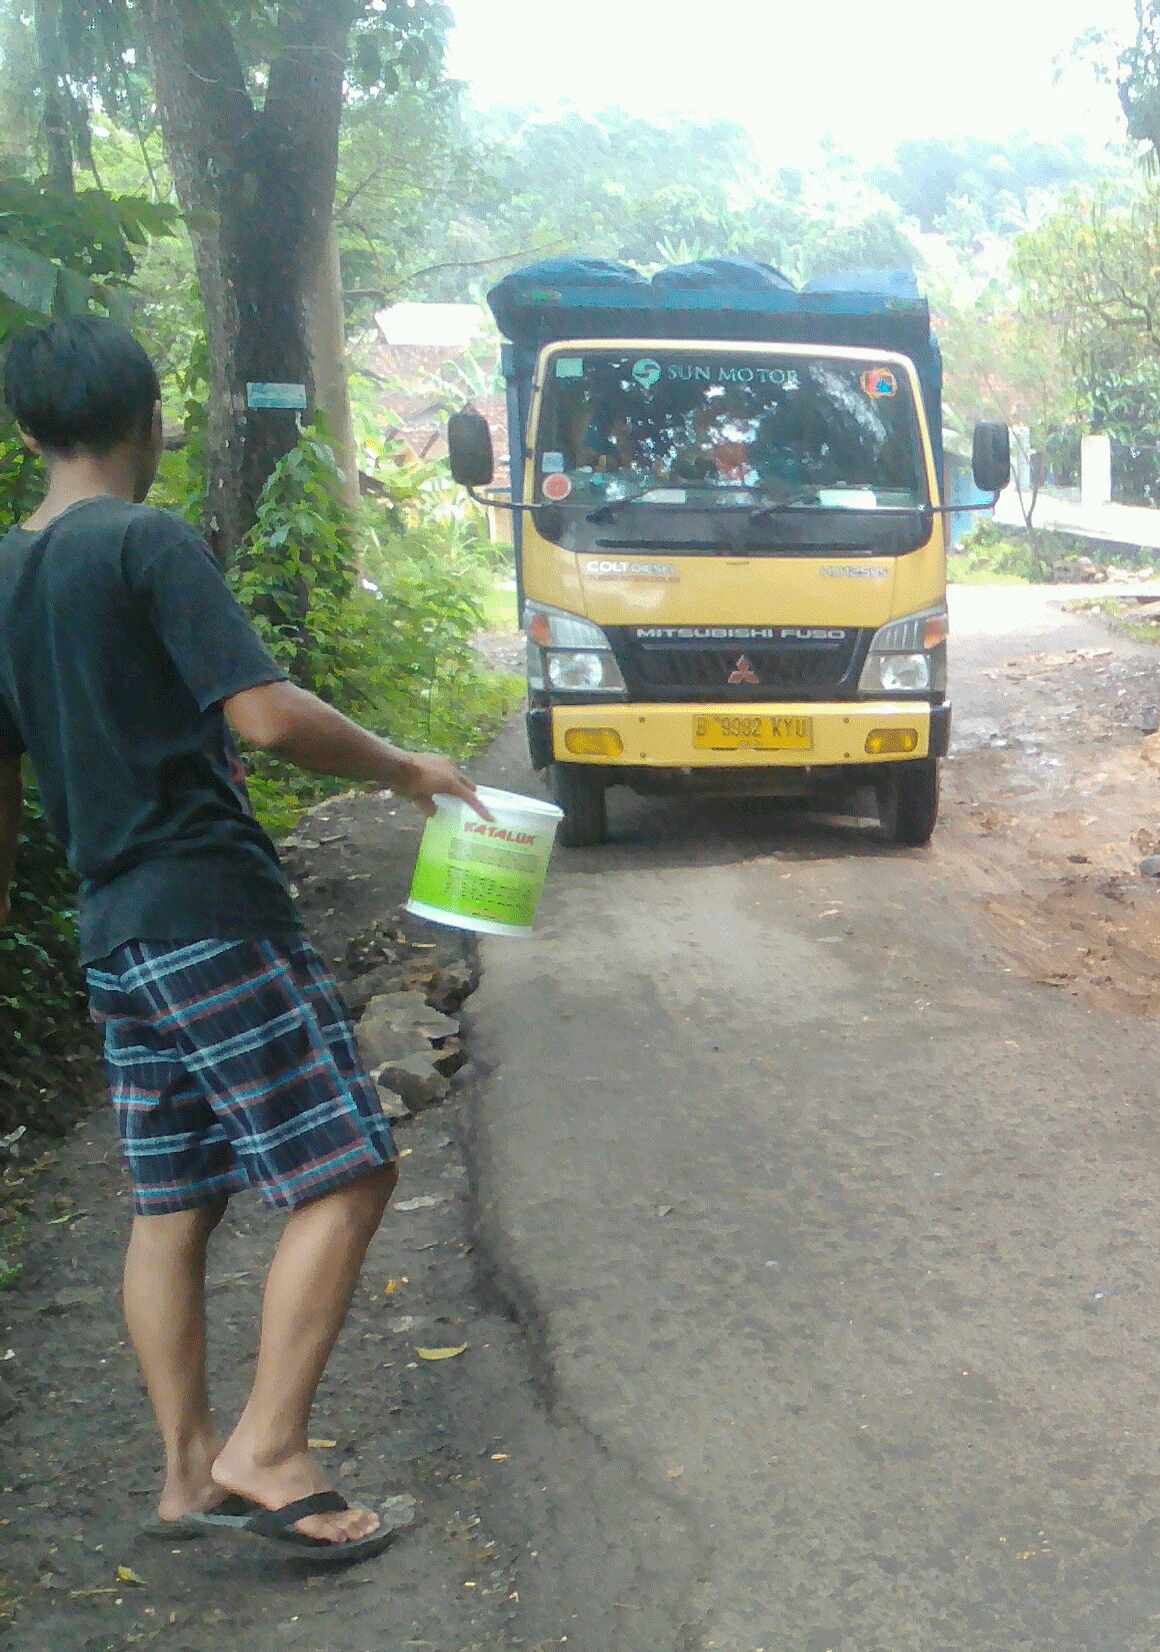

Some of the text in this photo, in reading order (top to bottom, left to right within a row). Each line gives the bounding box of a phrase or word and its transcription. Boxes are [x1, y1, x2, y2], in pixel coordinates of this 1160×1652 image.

[668, 364, 799, 386] SUN MOTOR
[585, 560, 628, 573] COLT
[636, 628, 846, 640] MITSUBISHI FUSO
[696, 717, 708, 736] B
[770, 716, 807, 739] KYU
